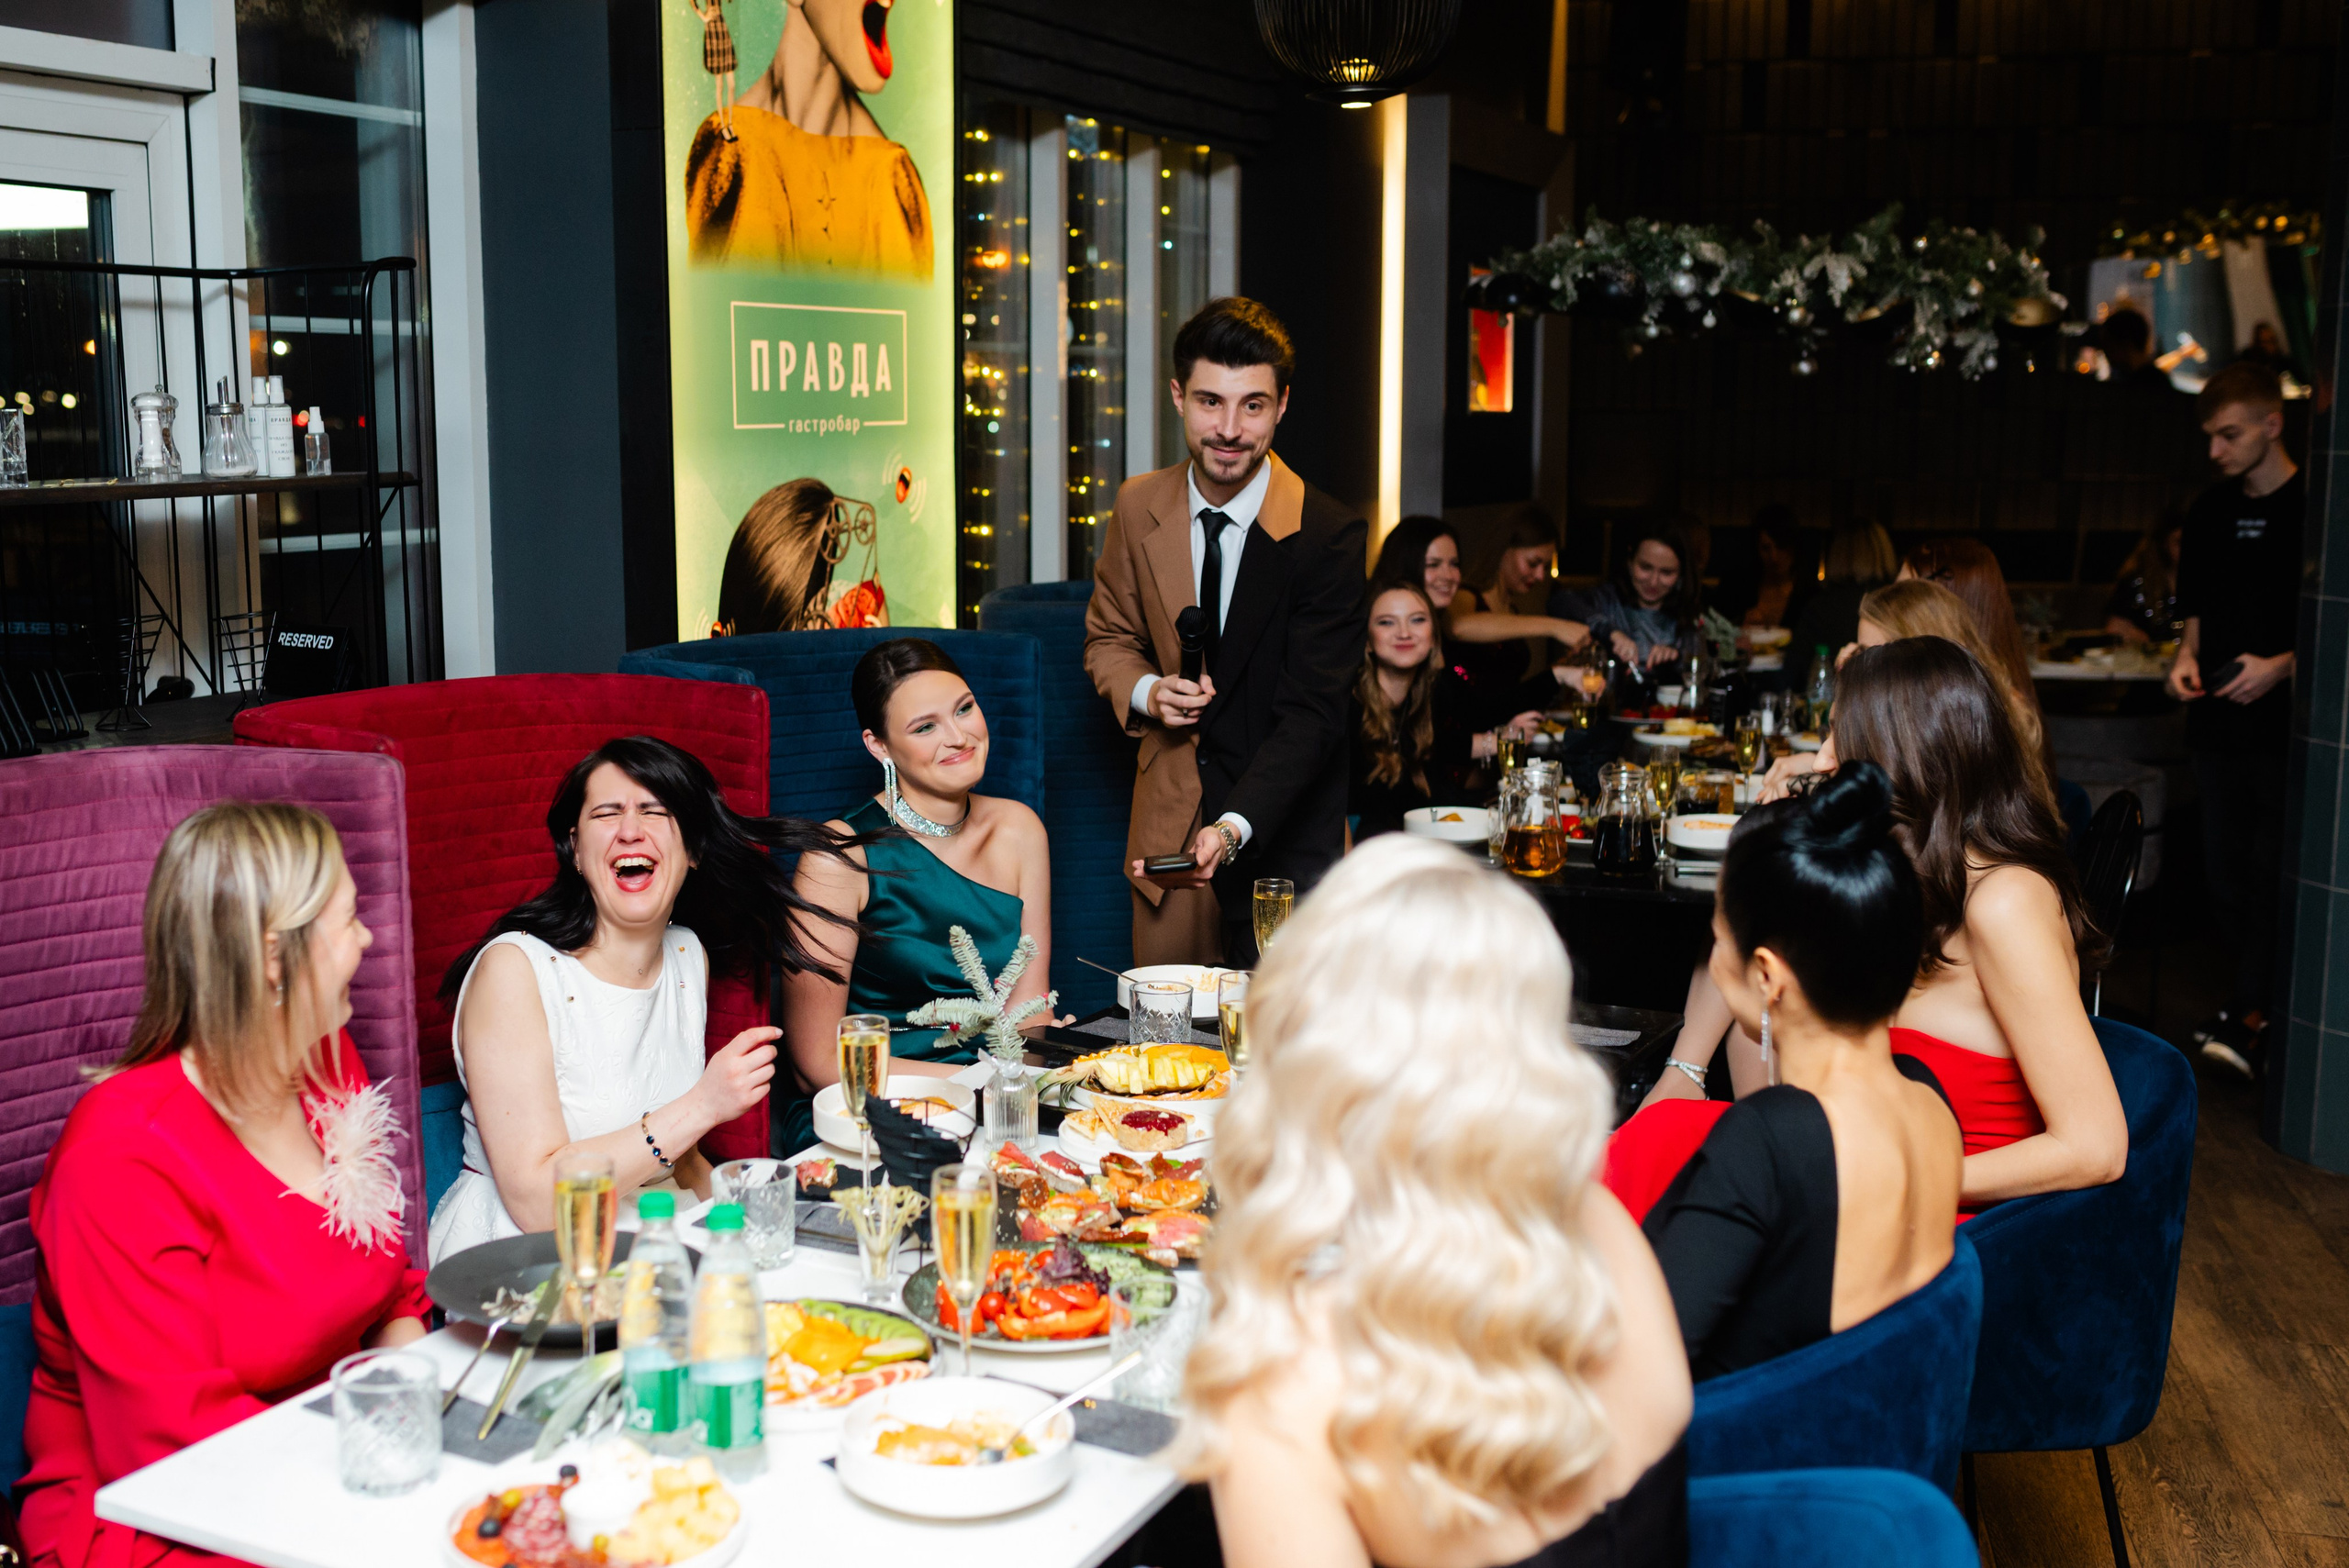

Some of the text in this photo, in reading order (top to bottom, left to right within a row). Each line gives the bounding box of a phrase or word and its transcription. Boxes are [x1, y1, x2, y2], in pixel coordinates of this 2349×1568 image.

[751, 339, 892, 398] ПРАВДА
[788, 414, 861, 437] гастробар
[278, 631, 334, 650] RESERVED
